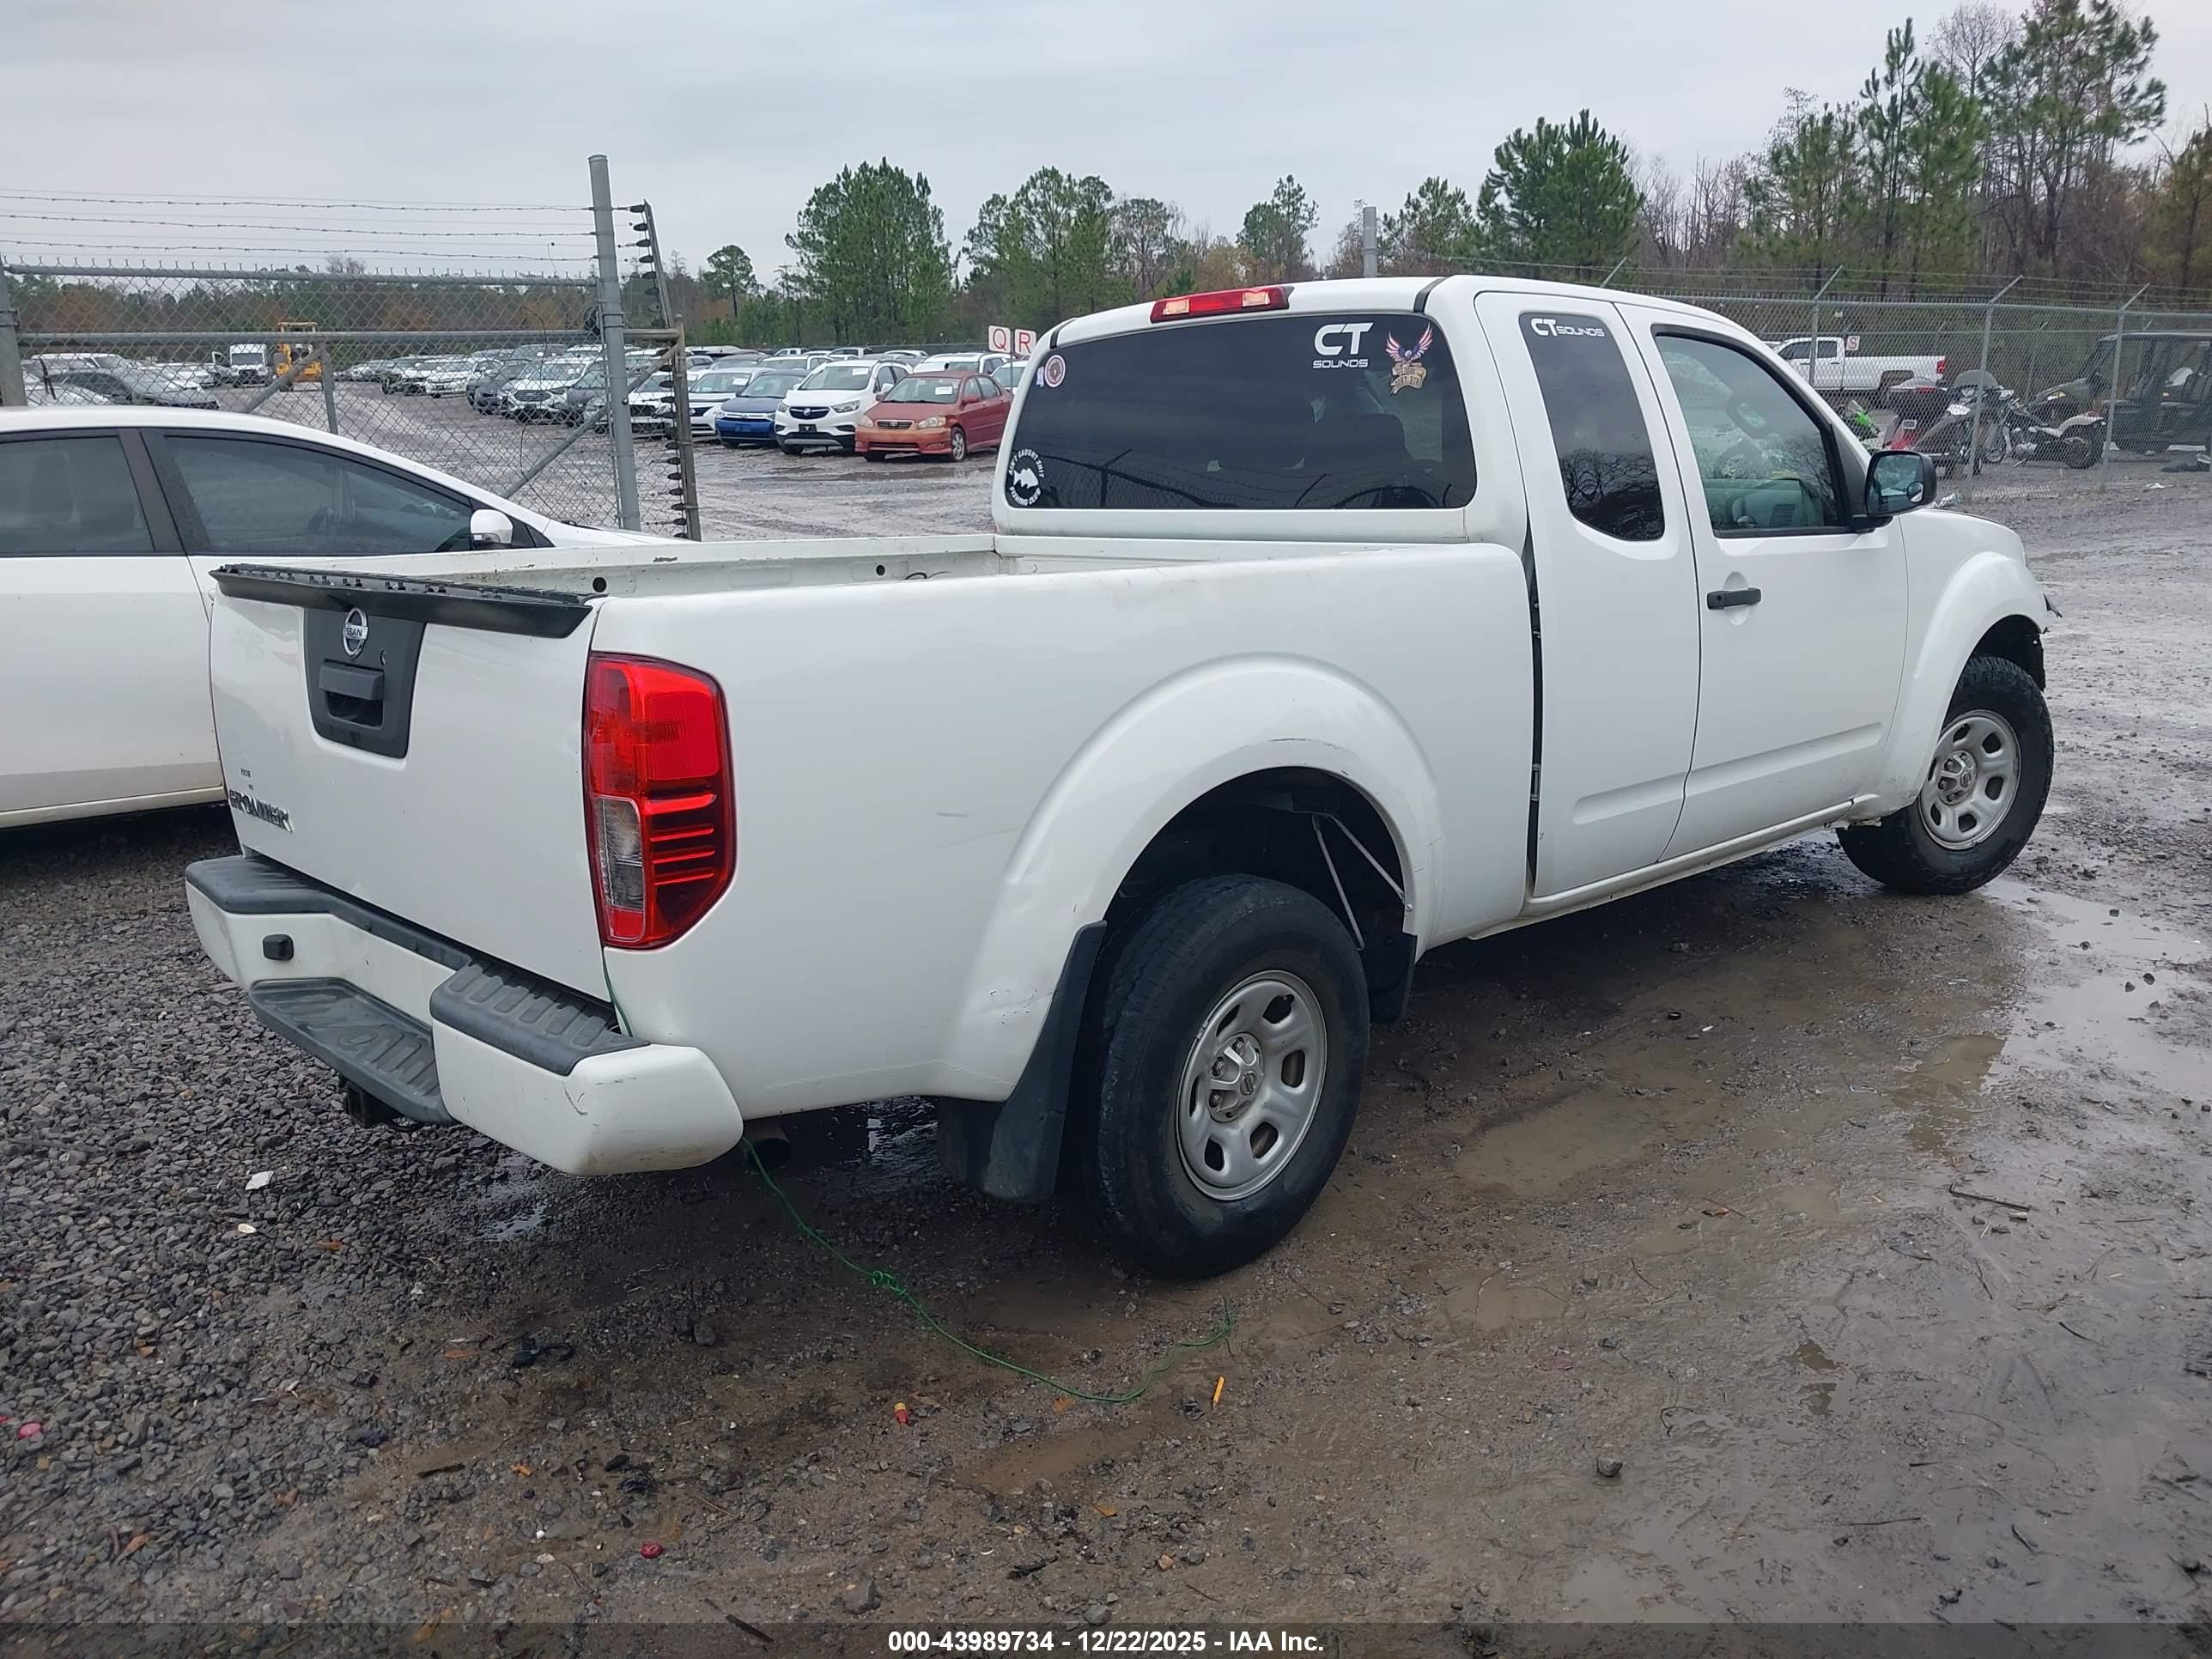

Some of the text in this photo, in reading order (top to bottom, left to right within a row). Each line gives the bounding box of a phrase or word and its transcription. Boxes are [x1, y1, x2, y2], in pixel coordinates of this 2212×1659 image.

[1531, 316, 1605, 337] CT SOUNDS
[993, 328, 1007, 351] Q
[1019, 331, 1031, 354] R
[1315, 322, 1374, 356] CT
[1312, 359, 1369, 368] SOUNDS
[1018, 448, 1039, 461] CAUGHT
[1036, 459, 1045, 478] SHIT
[1009, 486, 1042, 507] FISHING CLUB
[228, 788, 294, 833] FRONTIER
